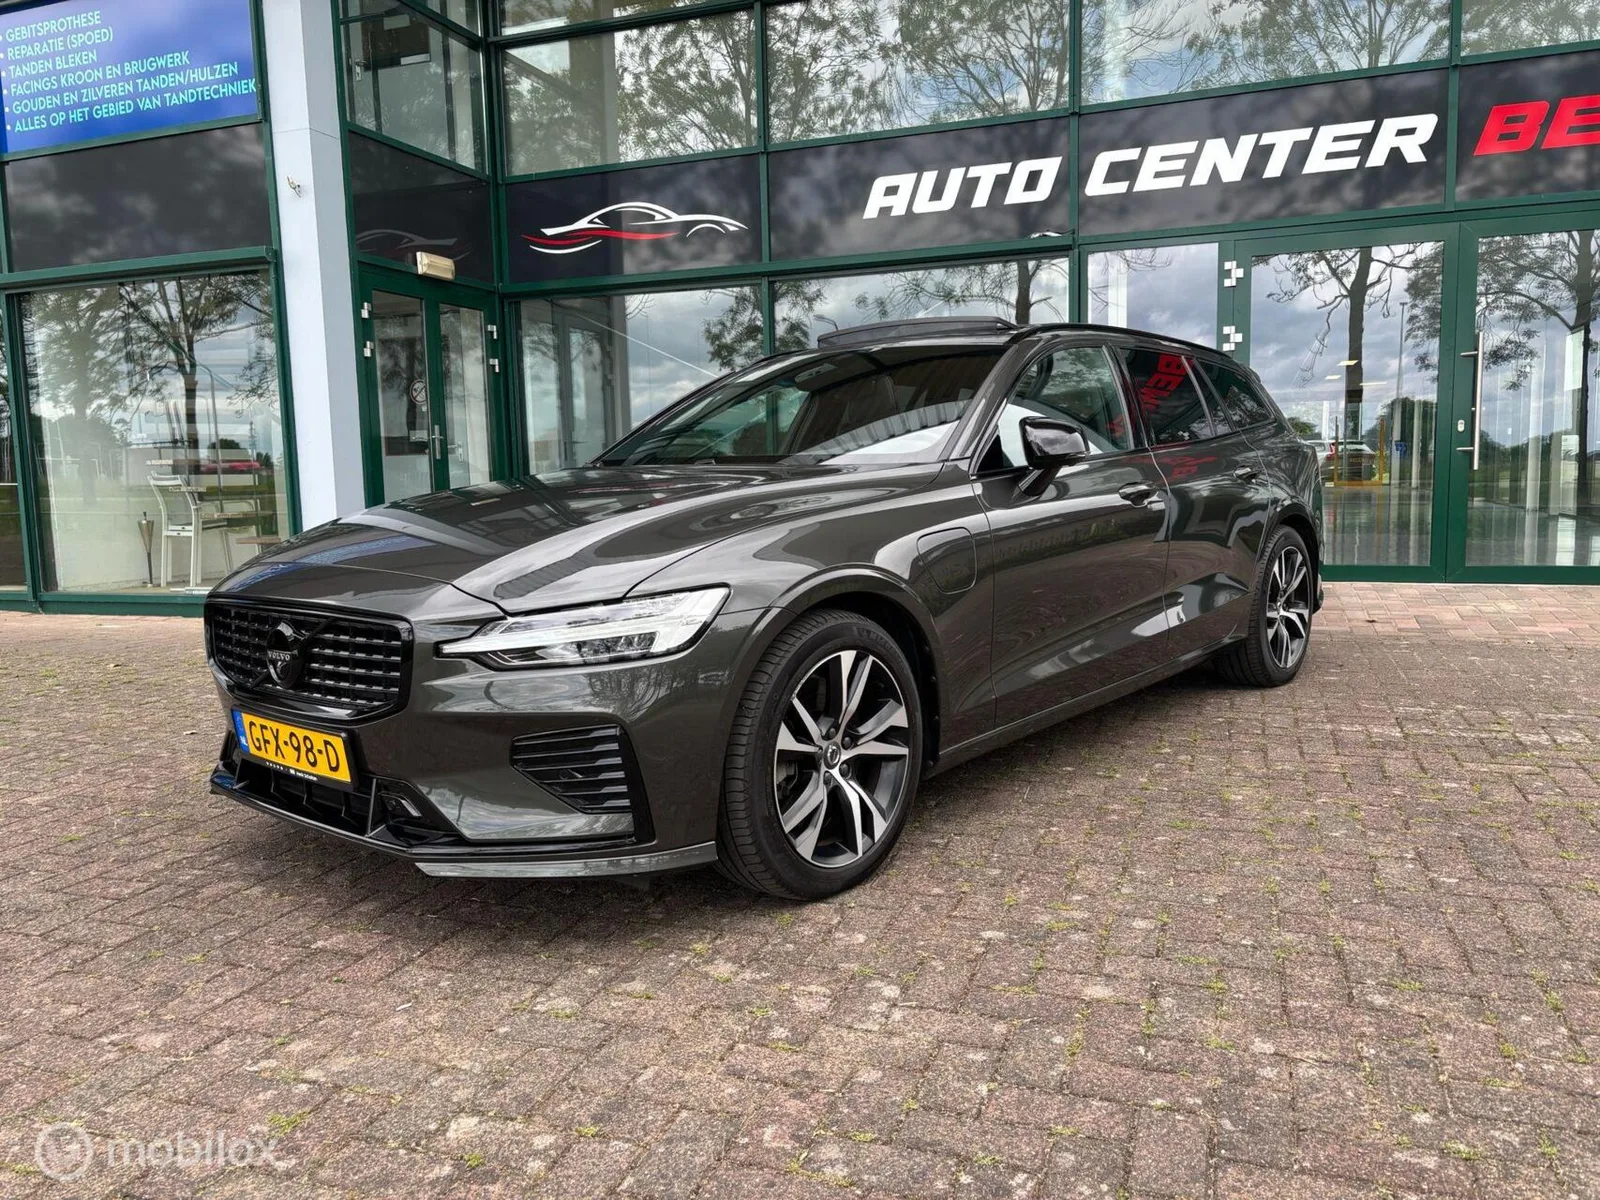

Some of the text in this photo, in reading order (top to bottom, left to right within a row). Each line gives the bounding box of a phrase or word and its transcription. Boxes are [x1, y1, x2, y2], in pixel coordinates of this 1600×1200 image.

[6, 11, 101, 42] GEBITSPROTHESE
[7, 26, 114, 61] REPARATIE (SPOED)
[9, 50, 97, 78] TANDEN BLEKEN
[11, 51, 191, 96] FACINGS KROON EN BRUGWERK
[12, 61, 238, 115] GOUDEN EN ZILVEREN TANDEN/HULZEN
[14, 78, 257, 133] ALLES OP HET GEBIED VAN TANDTECHNIEK
[863, 95, 1600, 220] AUTO CENTER BE
[268, 651, 291, 660] VOLVO
[249, 721, 340, 773] GFX-98-D
